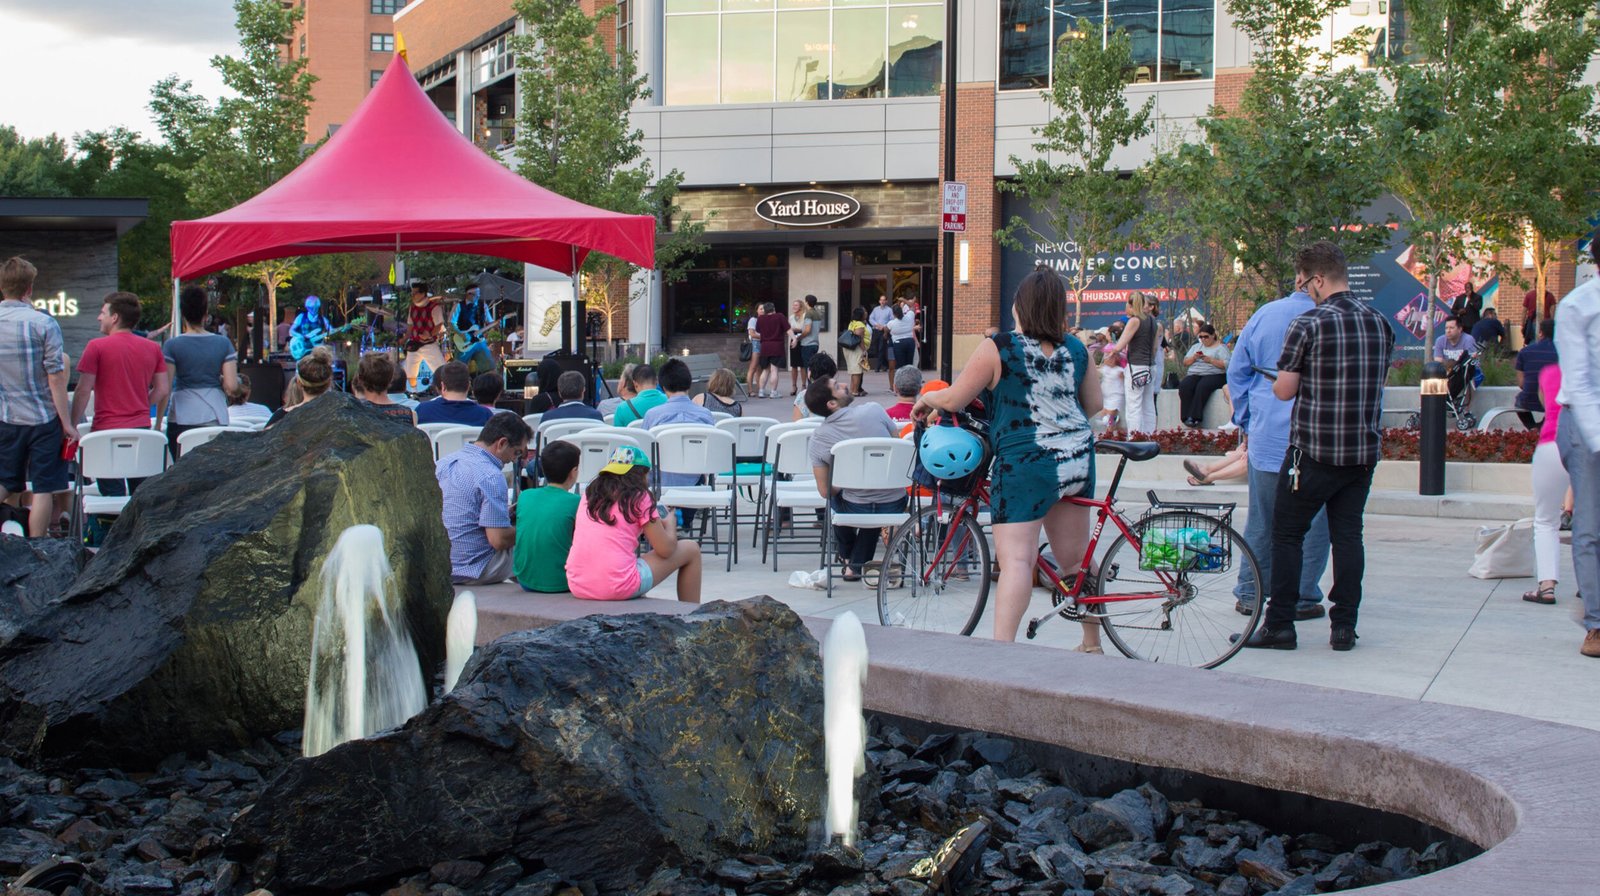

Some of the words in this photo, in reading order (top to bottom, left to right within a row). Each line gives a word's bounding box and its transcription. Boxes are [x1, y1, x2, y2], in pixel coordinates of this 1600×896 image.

[767, 200, 801, 217] Yard
[803, 199, 850, 216] House
[951, 214, 958, 222] NO
[944, 222, 964, 230] PARKING
[1035, 241, 1083, 254] NEWCI
[1113, 255, 1197, 270] CONCERT
[1073, 274, 1141, 283] SERIES
[1082, 291, 1128, 300] THURSDAY
[32, 290, 79, 316] arls
[1092, 522, 1103, 541] 700
